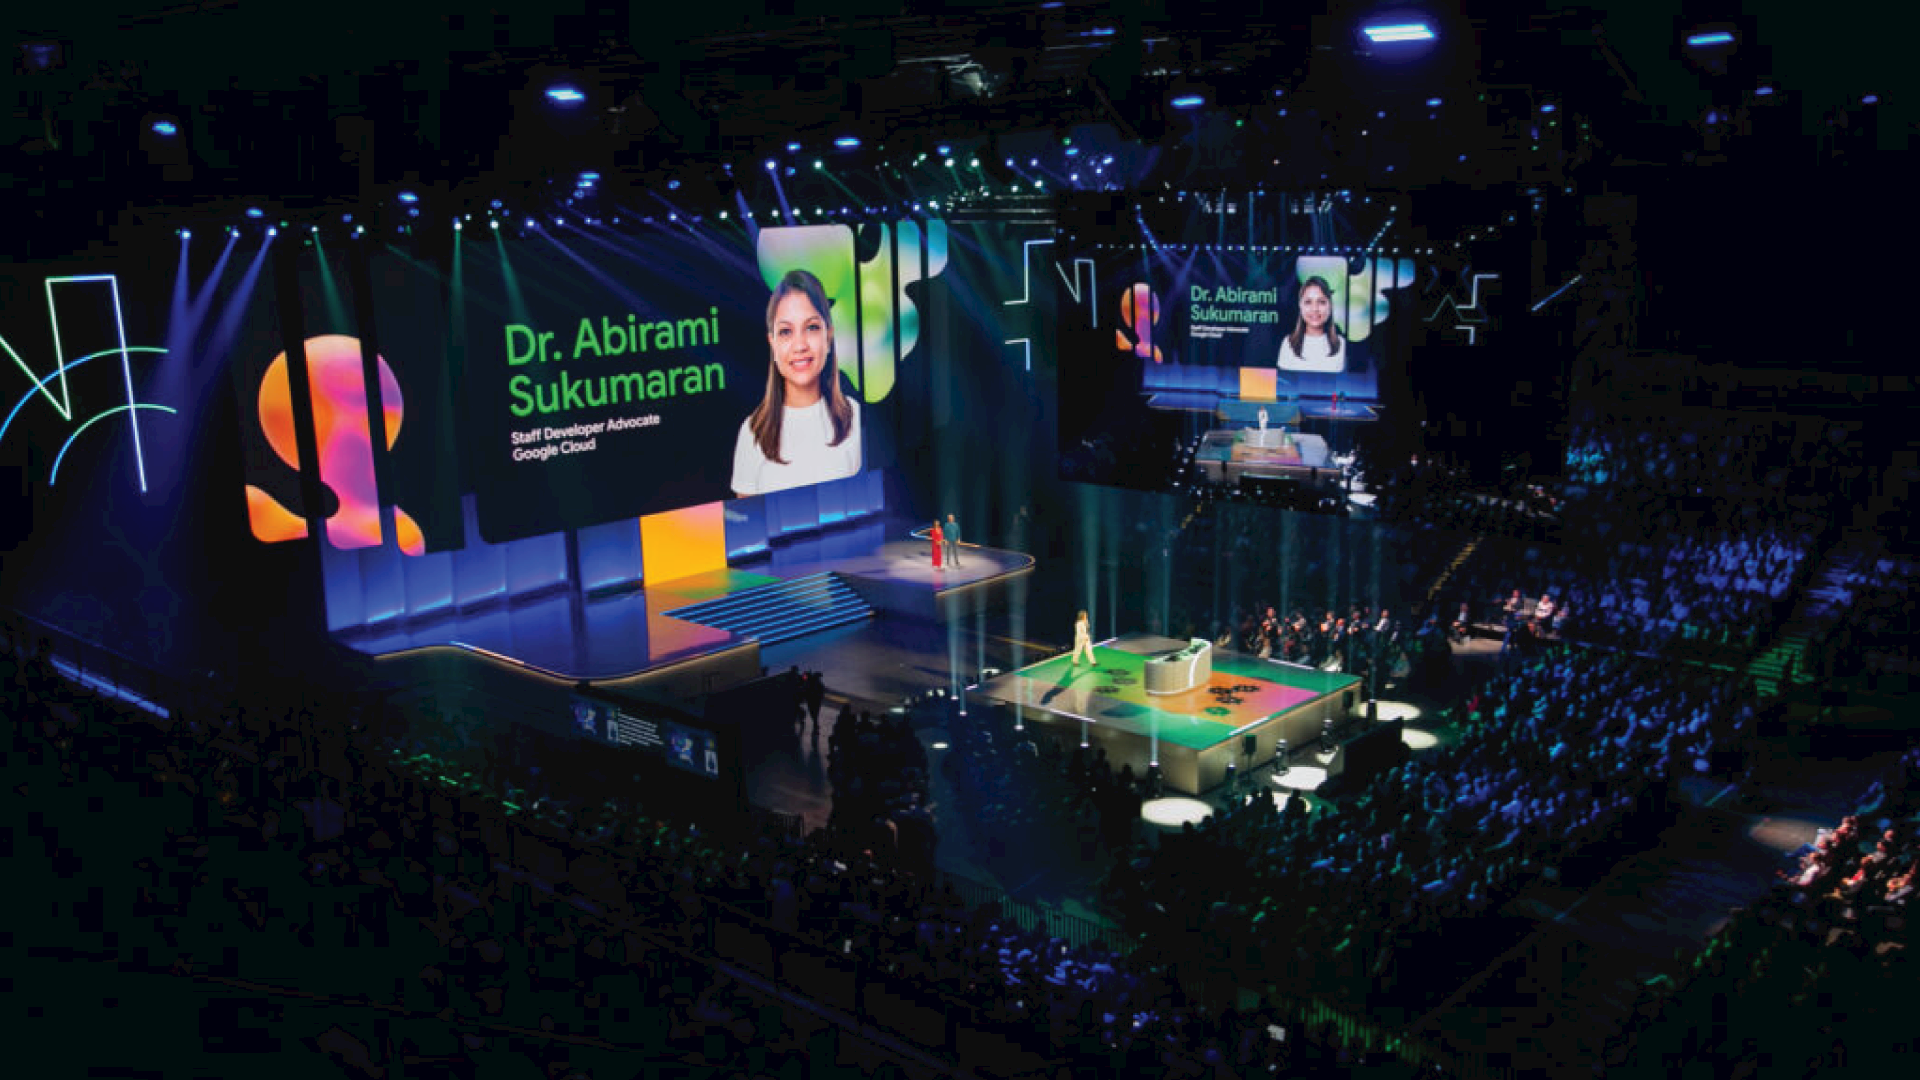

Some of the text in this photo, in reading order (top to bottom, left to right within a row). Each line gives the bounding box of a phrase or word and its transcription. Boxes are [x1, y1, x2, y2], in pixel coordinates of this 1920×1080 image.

[1190, 285, 1277, 304] Dr. Abirami
[1190, 304, 1279, 324] Sukumaran
[505, 306, 719, 366] Dr. Abirami
[509, 362, 726, 417] Sukumaran
[511, 414, 661, 444] Staff Developer Advocate
[512, 438, 597, 461] Google Cloud
